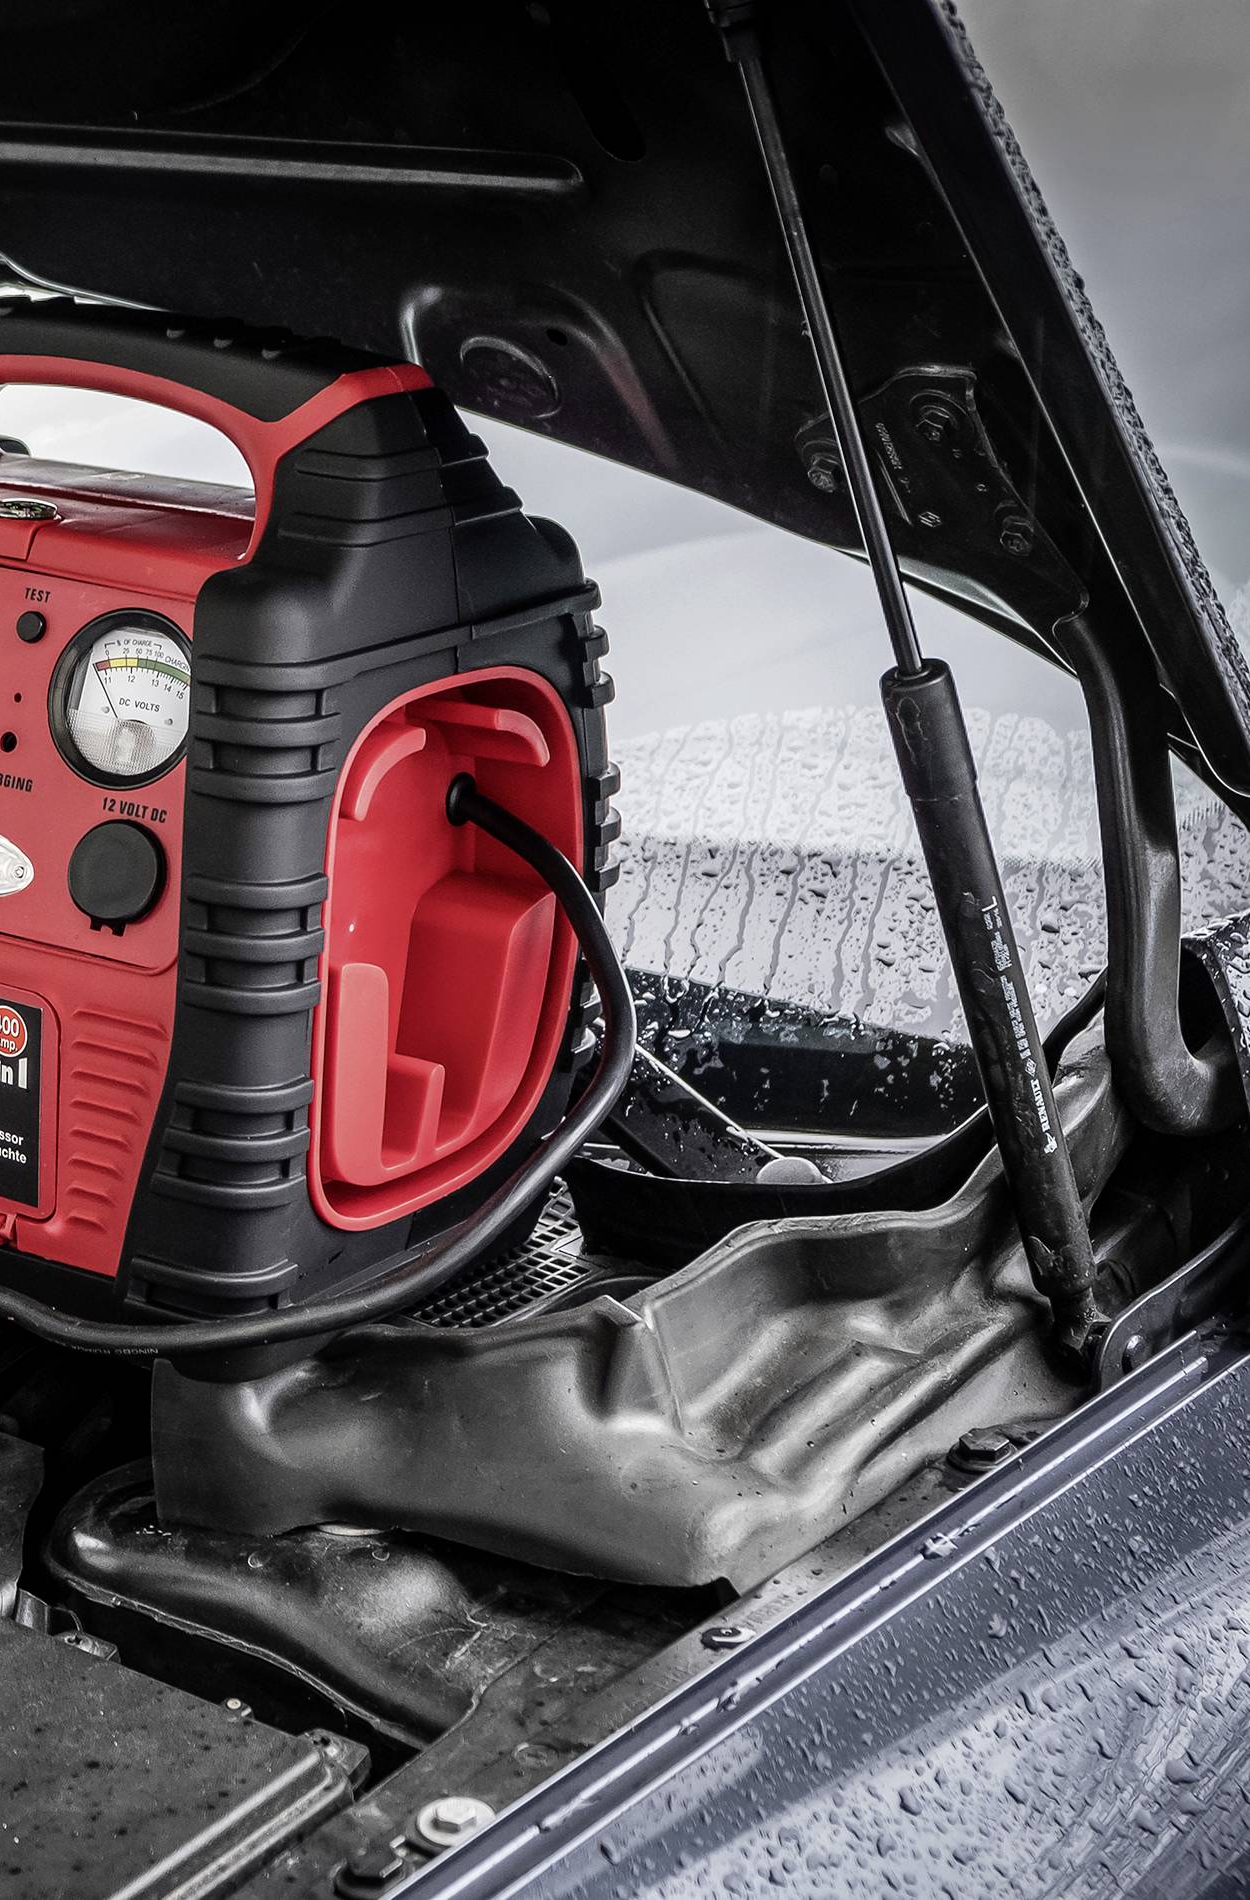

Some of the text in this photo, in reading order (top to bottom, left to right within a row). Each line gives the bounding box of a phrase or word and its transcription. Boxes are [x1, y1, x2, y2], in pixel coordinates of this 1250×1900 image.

[24, 587, 51, 603] TEST
[154, 650, 164, 659] 100
[104, 675, 185, 700] 11 12 13 14 15
[118, 697, 161, 713] DC VOLTS
[102, 796, 168, 823] 12 VOLT DC
[982, 895, 998, 912] L
[17, 1056, 29, 1090] 1
[1030, 1077, 1050, 1133] RENAULT
